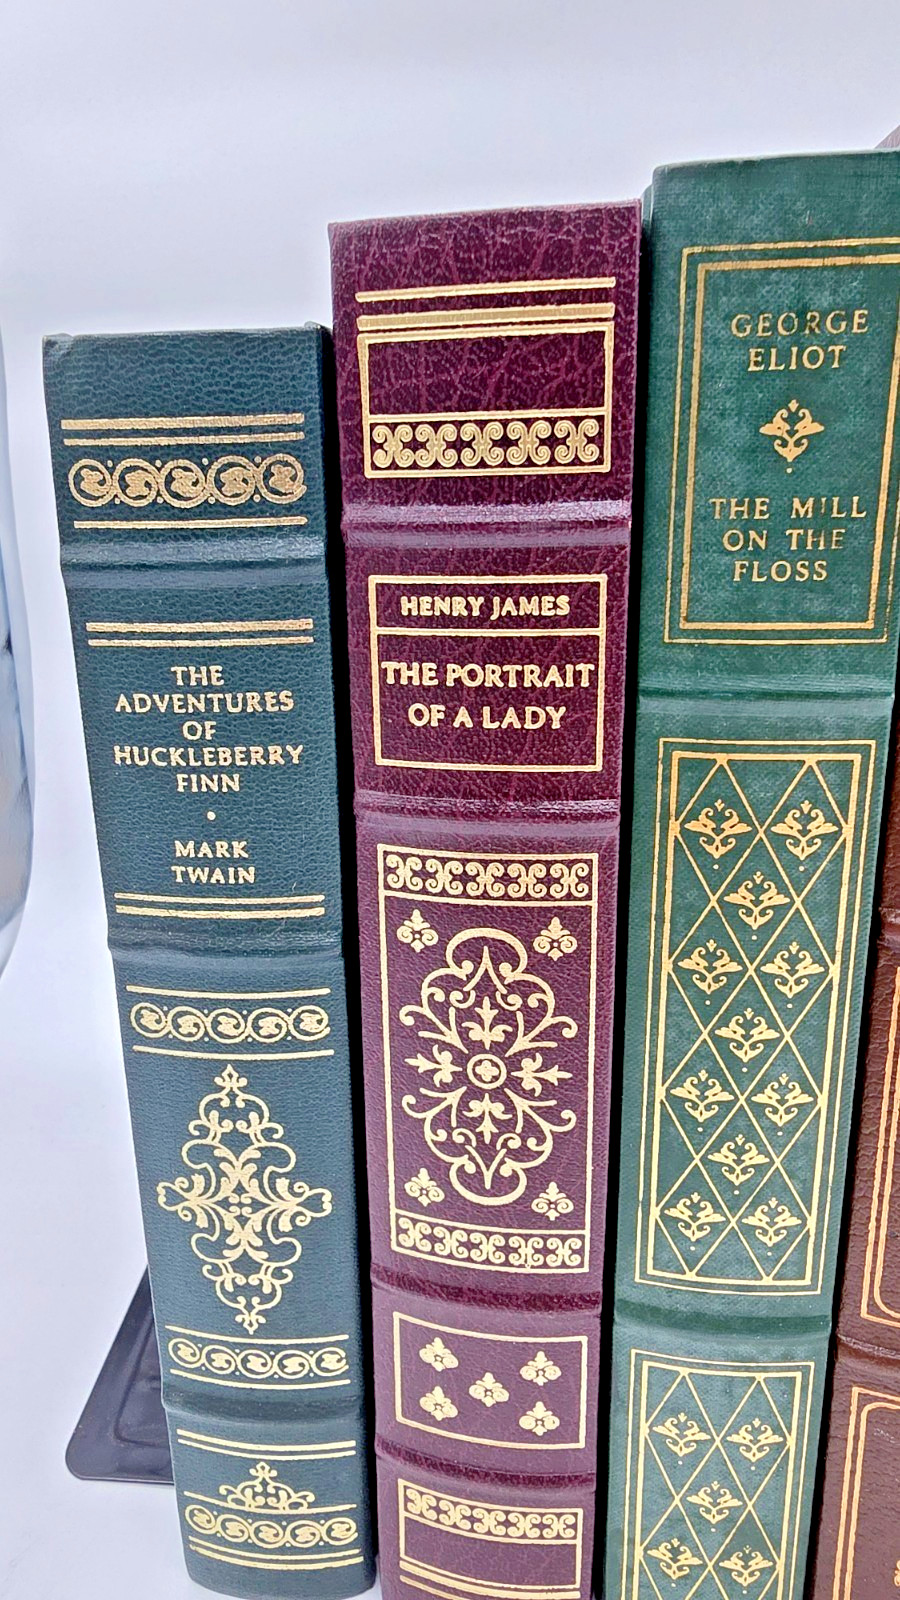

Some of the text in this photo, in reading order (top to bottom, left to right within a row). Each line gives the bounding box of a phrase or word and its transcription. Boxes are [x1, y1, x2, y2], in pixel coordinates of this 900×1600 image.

[731, 310, 869, 337] GEORGE
[747, 345, 846, 371] ELIOT
[709, 496, 867, 520] THE MILL
[722, 528, 845, 551] ON THE
[733, 560, 828, 582] FLOSS
[400, 595, 570, 620] HENRY JAMES
[171, 665, 224, 686] THE
[381, 662, 595, 688] THE PORTRAIT
[115, 691, 294, 714] ADVENTURES
[408, 703, 566, 729] OF A LADY
[182, 720, 217, 741] OF
[113, 745, 304, 767] HUCKLEBERRY
[176, 773, 241, 793] FINN
[174, 840, 250, 859] MARK
[171, 866, 256, 884] TWAIN
